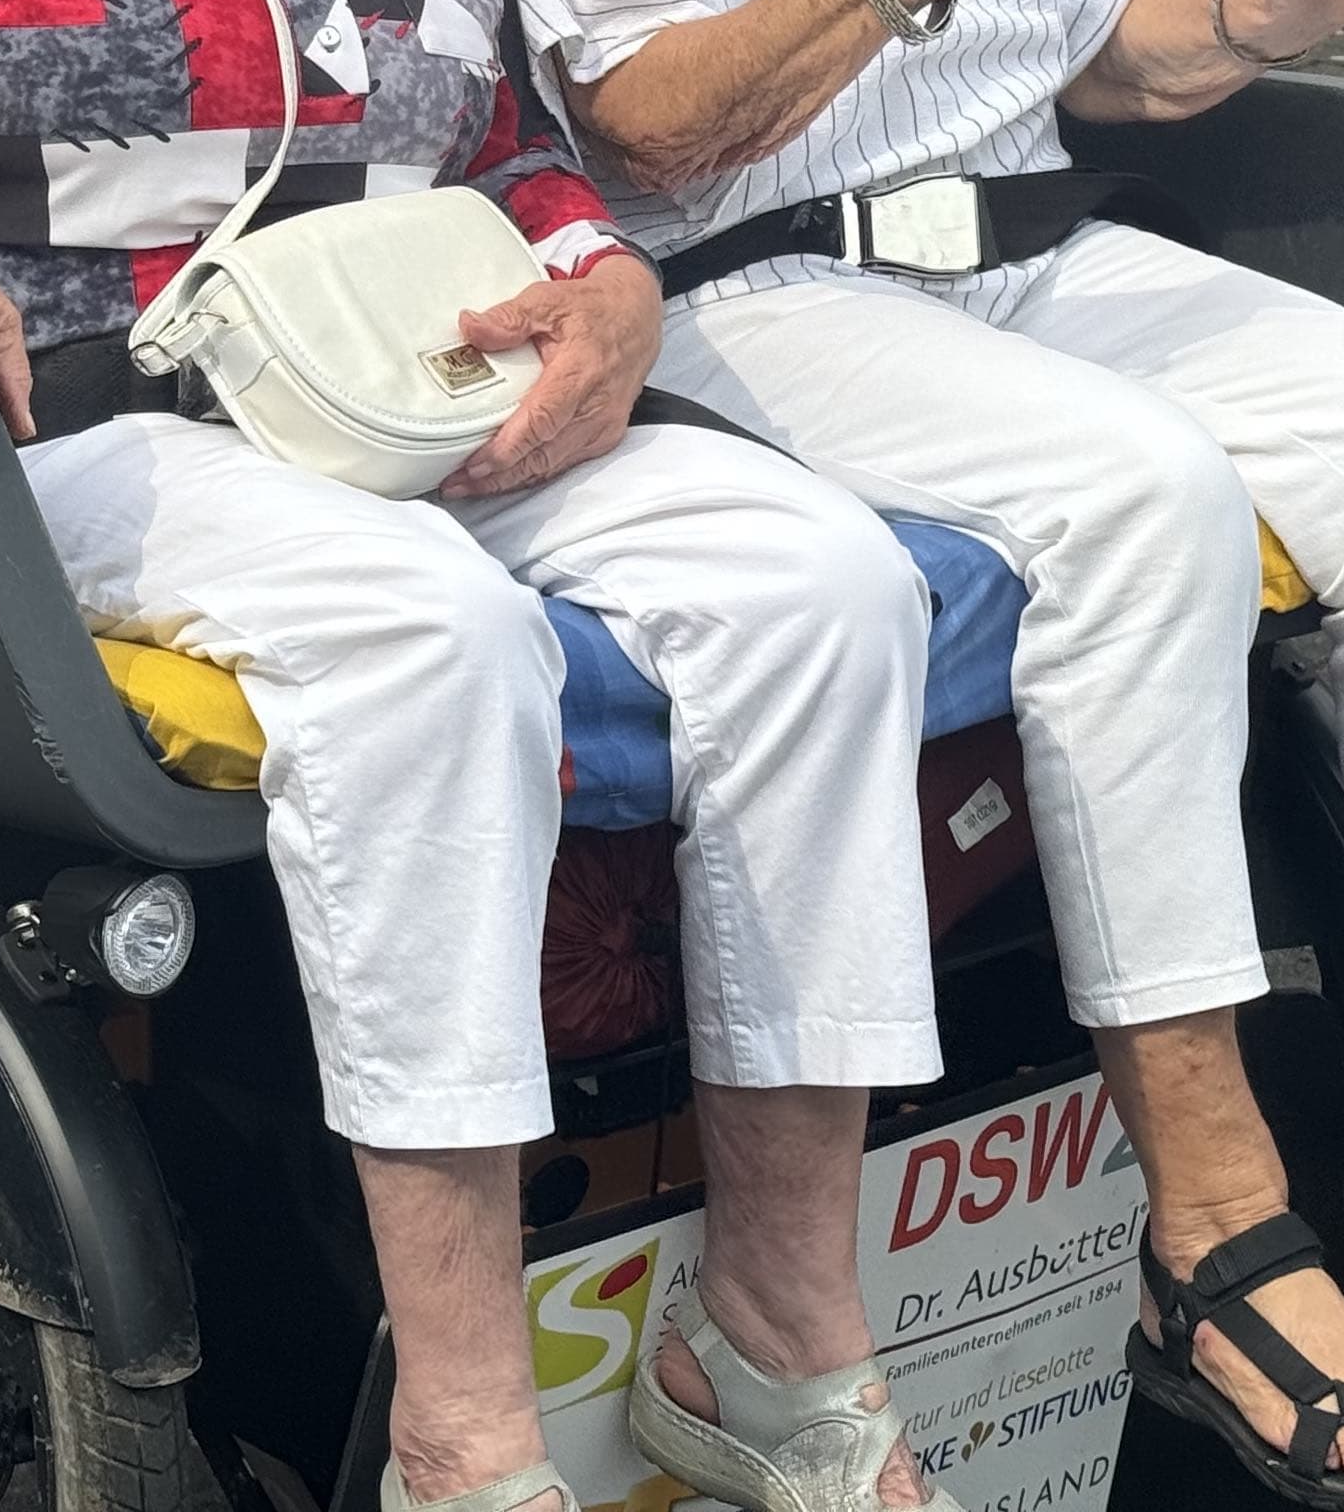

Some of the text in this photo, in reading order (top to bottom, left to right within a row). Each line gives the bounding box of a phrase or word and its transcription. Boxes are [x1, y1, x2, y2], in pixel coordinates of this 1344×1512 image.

[894, 1206, 1139, 1334] Dr. Ausbüttel
[885, 1279, 1124, 1382] Familienunternehmen seit 1894
[901, 1345, 1095, 1434] rtur und Lieselotte
[997, 1369, 1133, 1448] STIFTUNG
